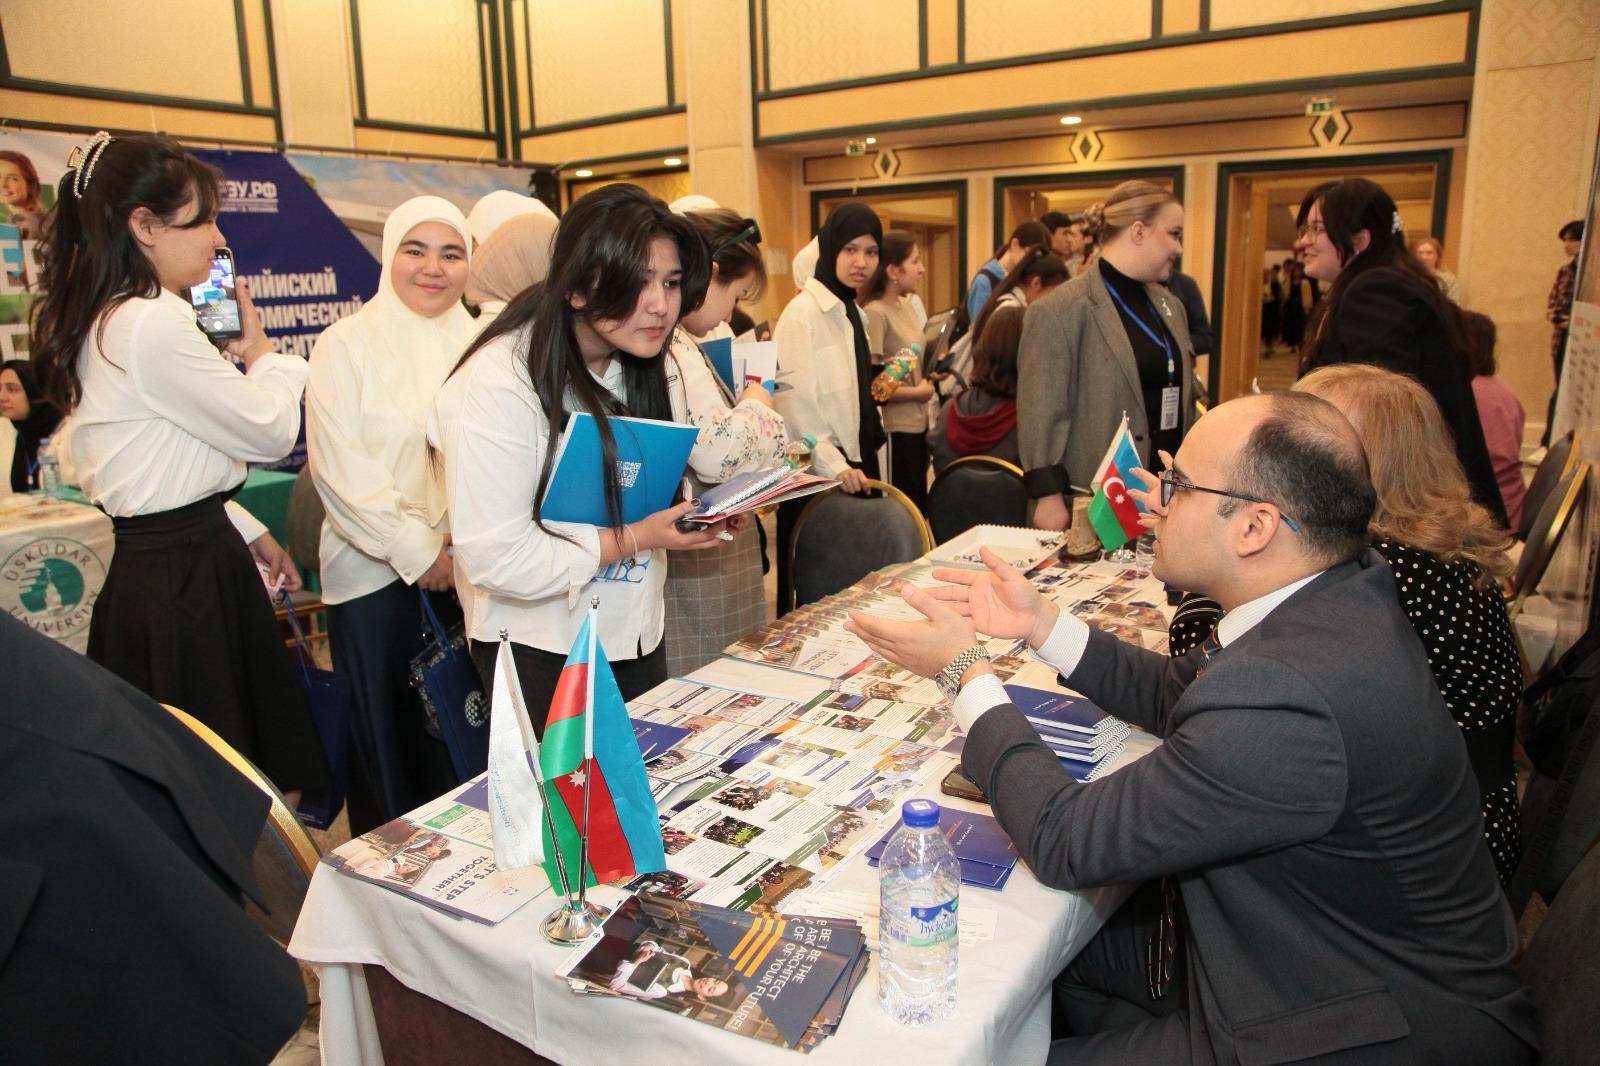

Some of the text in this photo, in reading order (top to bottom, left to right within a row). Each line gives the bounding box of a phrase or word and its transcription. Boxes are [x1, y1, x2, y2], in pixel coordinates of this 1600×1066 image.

[432, 855, 489, 892] TOGETHER!
[446, 879, 476, 901] STEP
[782, 942, 796, 959] OF
[806, 948, 822, 964] BE
[759, 958, 787, 986] YOUR
[766, 945, 808, 1001] ARCHITECT
[792, 964, 813, 984] THE
